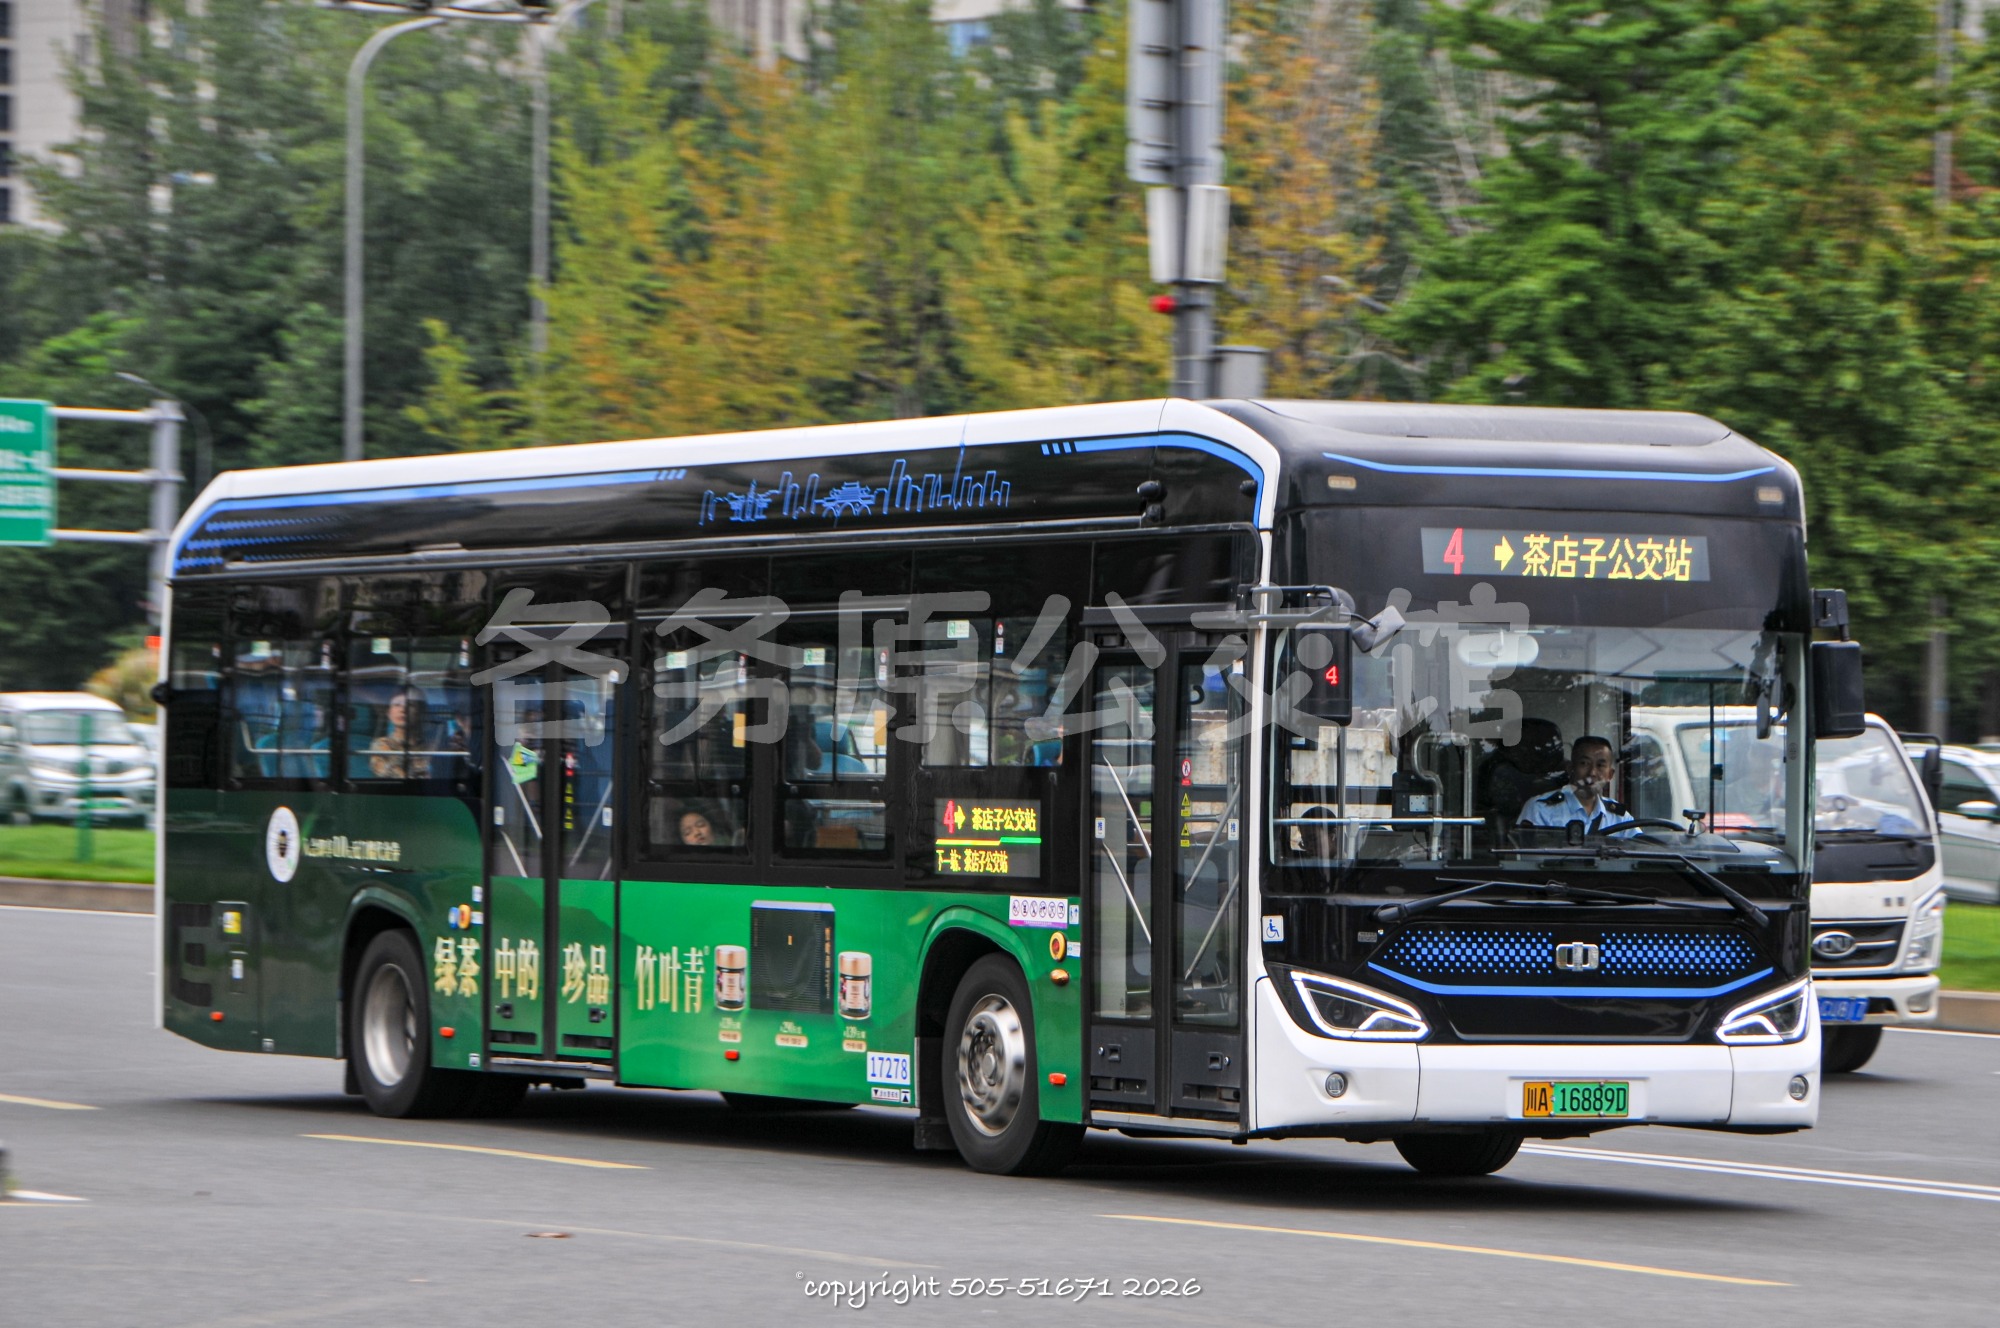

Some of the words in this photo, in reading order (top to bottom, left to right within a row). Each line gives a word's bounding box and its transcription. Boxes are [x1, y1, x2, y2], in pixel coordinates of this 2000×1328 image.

[1443, 528, 1465, 575] 4
[1522, 534, 1693, 581] 茶店子公交站
[1325, 665, 1339, 686] 4
[943, 800, 956, 834] 4
[971, 807, 1037, 832] 茶店子公交站
[635, 945, 705, 1013] 竹叶青
[871, 1056, 907, 1080] 17278
